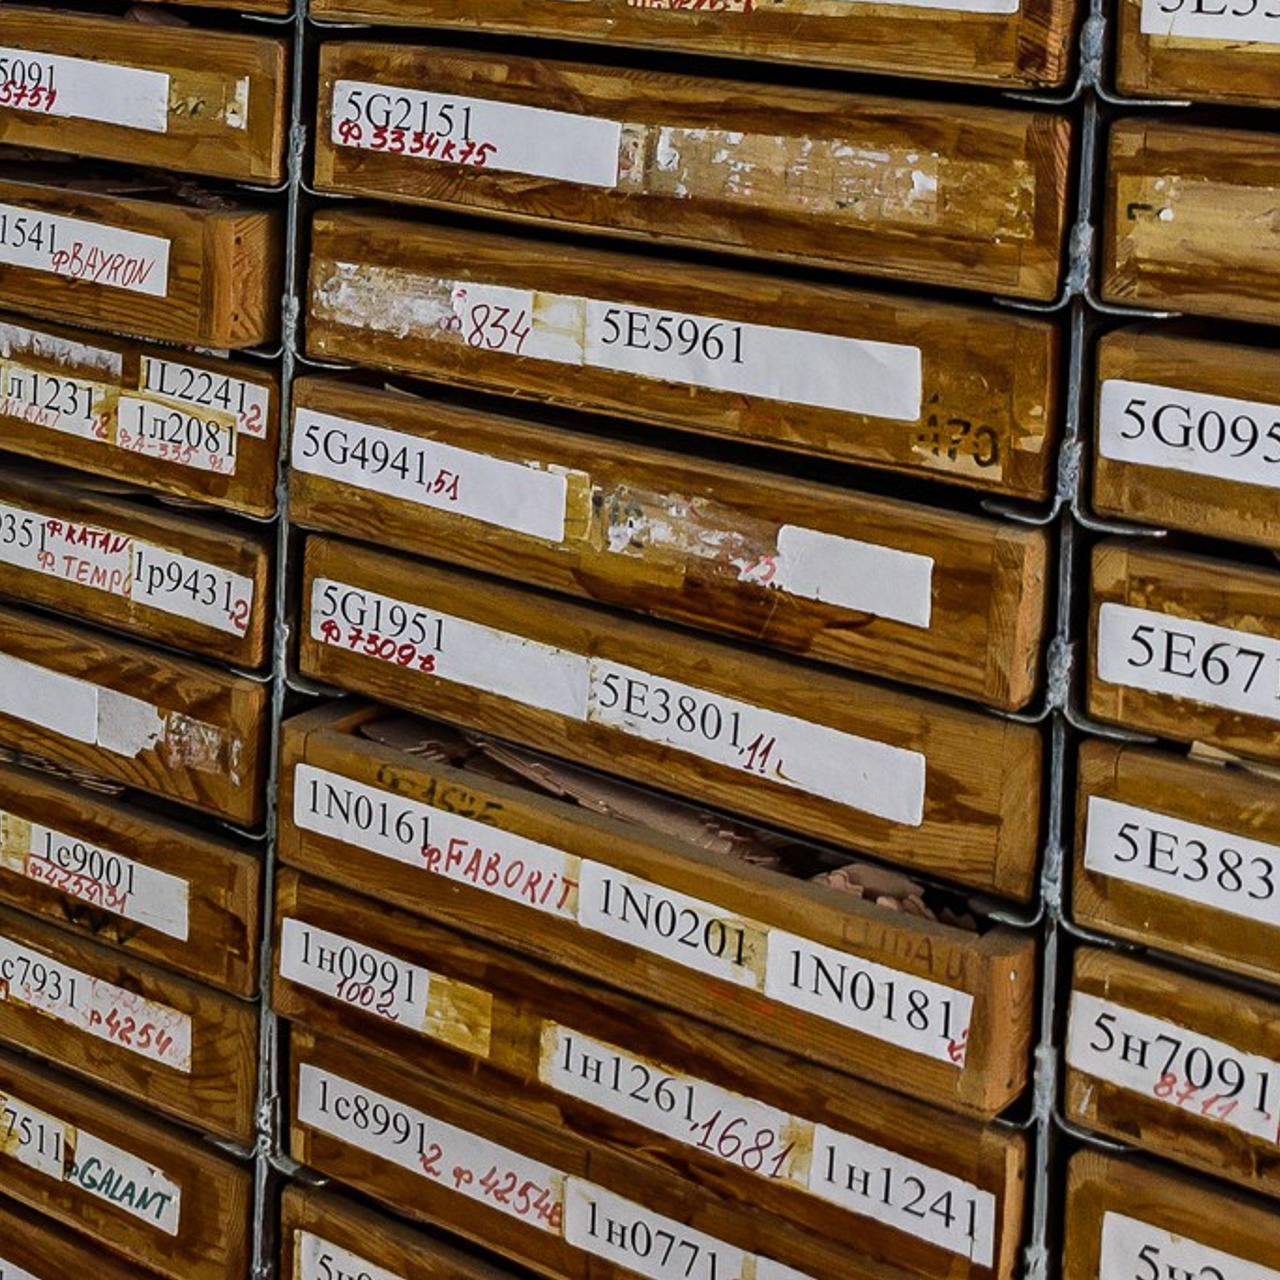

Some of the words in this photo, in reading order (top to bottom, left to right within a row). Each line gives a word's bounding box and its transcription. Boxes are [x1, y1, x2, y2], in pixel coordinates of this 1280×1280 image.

[345, 87, 474, 142] 5G2151
[467, 303, 532, 355] 834
[602, 309, 743, 363] 5E5961
[139, 360, 245, 413] 1L2241
[303, 424, 425, 485] 5G4941
[135, 552, 231, 612] 1p9431
[321, 586, 442, 651] 5G1951
[1128, 625, 1280, 701] 5E67
[600, 674, 739, 747] 5E3801
[308, 781, 431, 848] 1N0161
[46, 832, 133, 894] 1c9001
[603, 880, 743, 964] 1N0201
[301, 930, 414, 1004] 1н0991
[792, 951, 950, 1039] 1N0181
[564, 1035, 693, 1122] 1н1261
[1090, 1013, 1273, 1113] 5н7091
[320, 1081, 426, 1157] 1c8991
[827, 1146, 975, 1240] 1н1241
